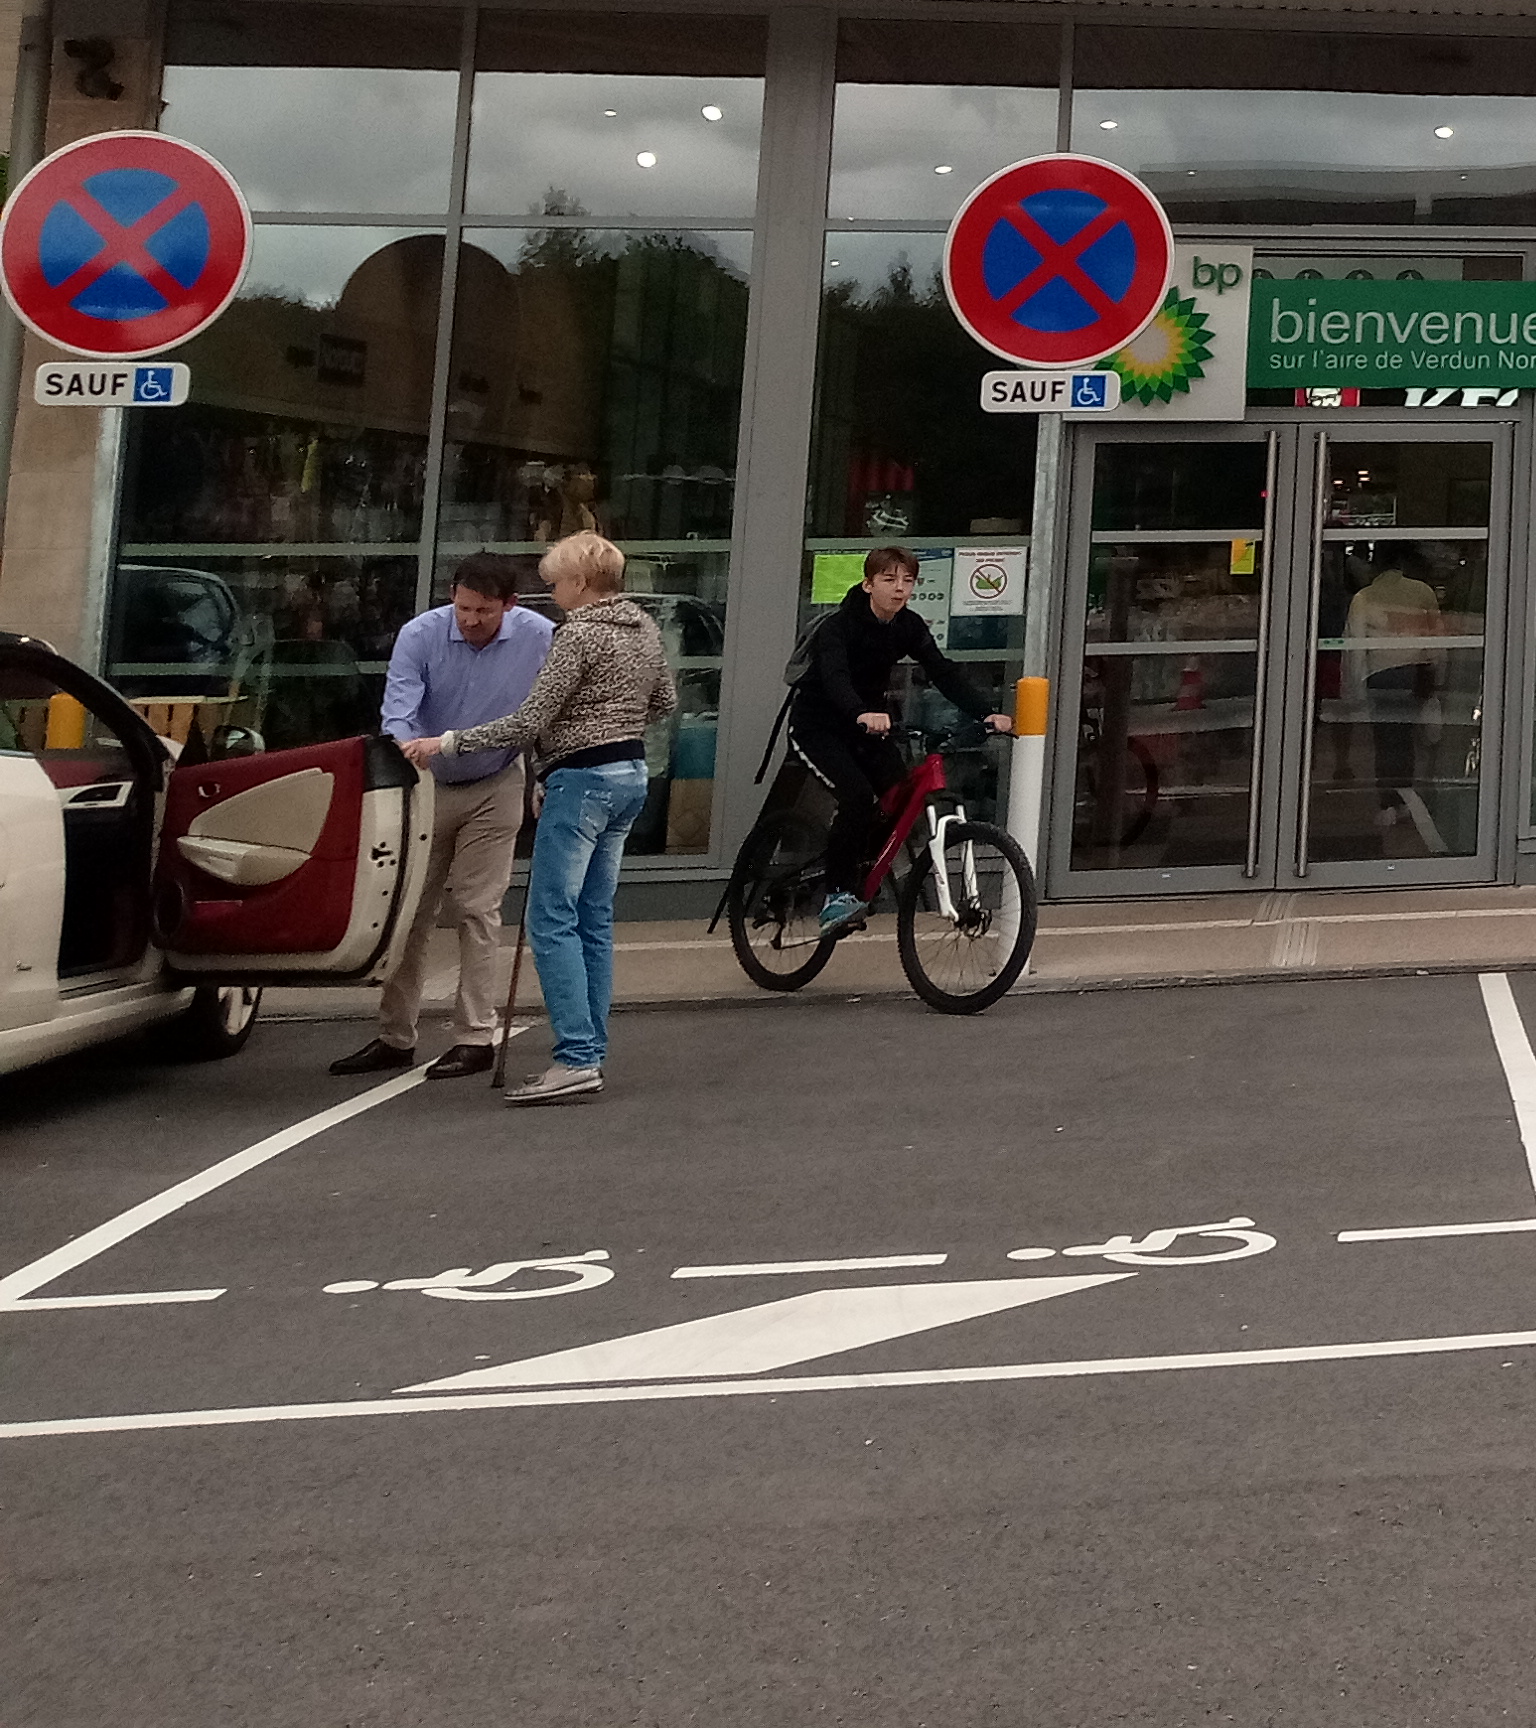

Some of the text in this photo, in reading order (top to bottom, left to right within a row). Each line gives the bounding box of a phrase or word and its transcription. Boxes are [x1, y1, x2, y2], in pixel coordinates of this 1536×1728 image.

[1193, 255, 1244, 295] bp
[1269, 352, 1305, 370] sur
[1311, 350, 1368, 370] l'aire
[1375, 351, 1403, 370] de
[1410, 350, 1490, 370] Verdun
[45, 373, 128, 396] SAUF
[991, 381, 1066, 403] SAUF
